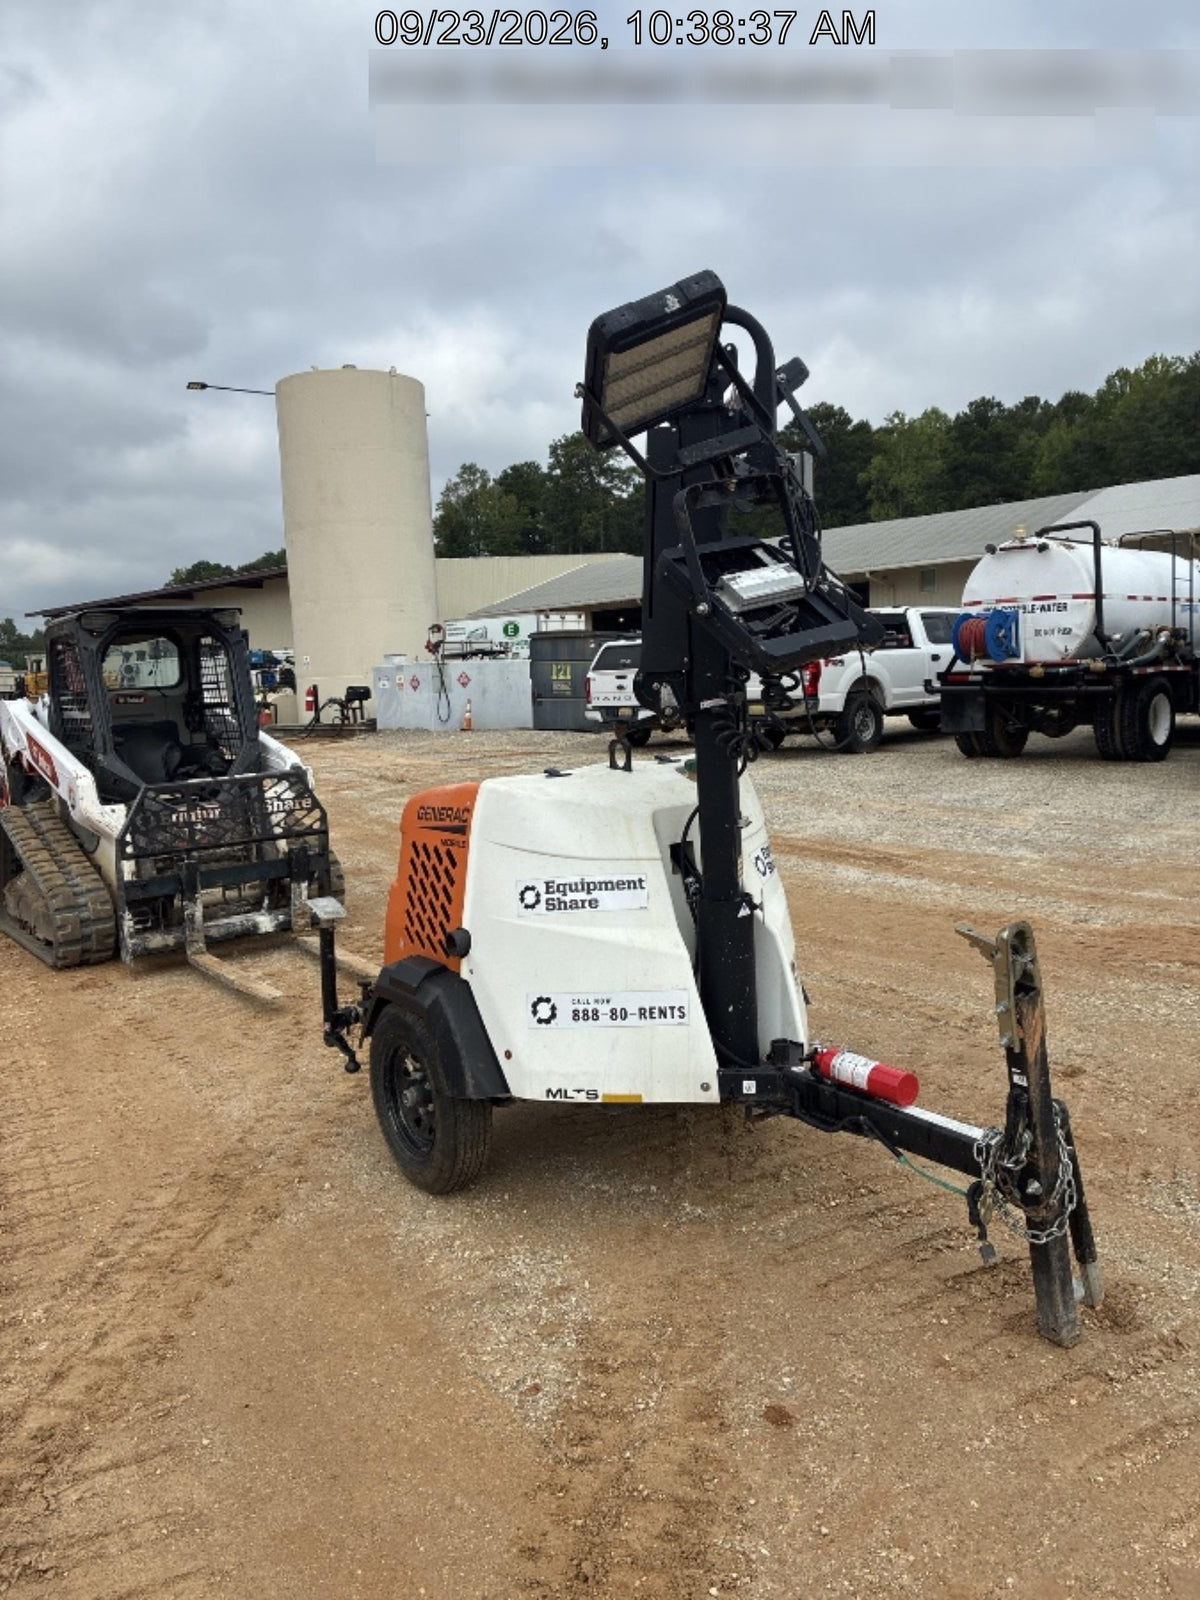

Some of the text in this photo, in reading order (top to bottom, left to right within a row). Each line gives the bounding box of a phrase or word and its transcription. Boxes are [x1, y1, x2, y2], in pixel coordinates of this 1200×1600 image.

[417, 806, 471, 823] GENERAC
[543, 877, 646, 896] Equipment
[545, 897, 600, 911] Share
[571, 1005, 687, 1022] 888-80-RENTS
